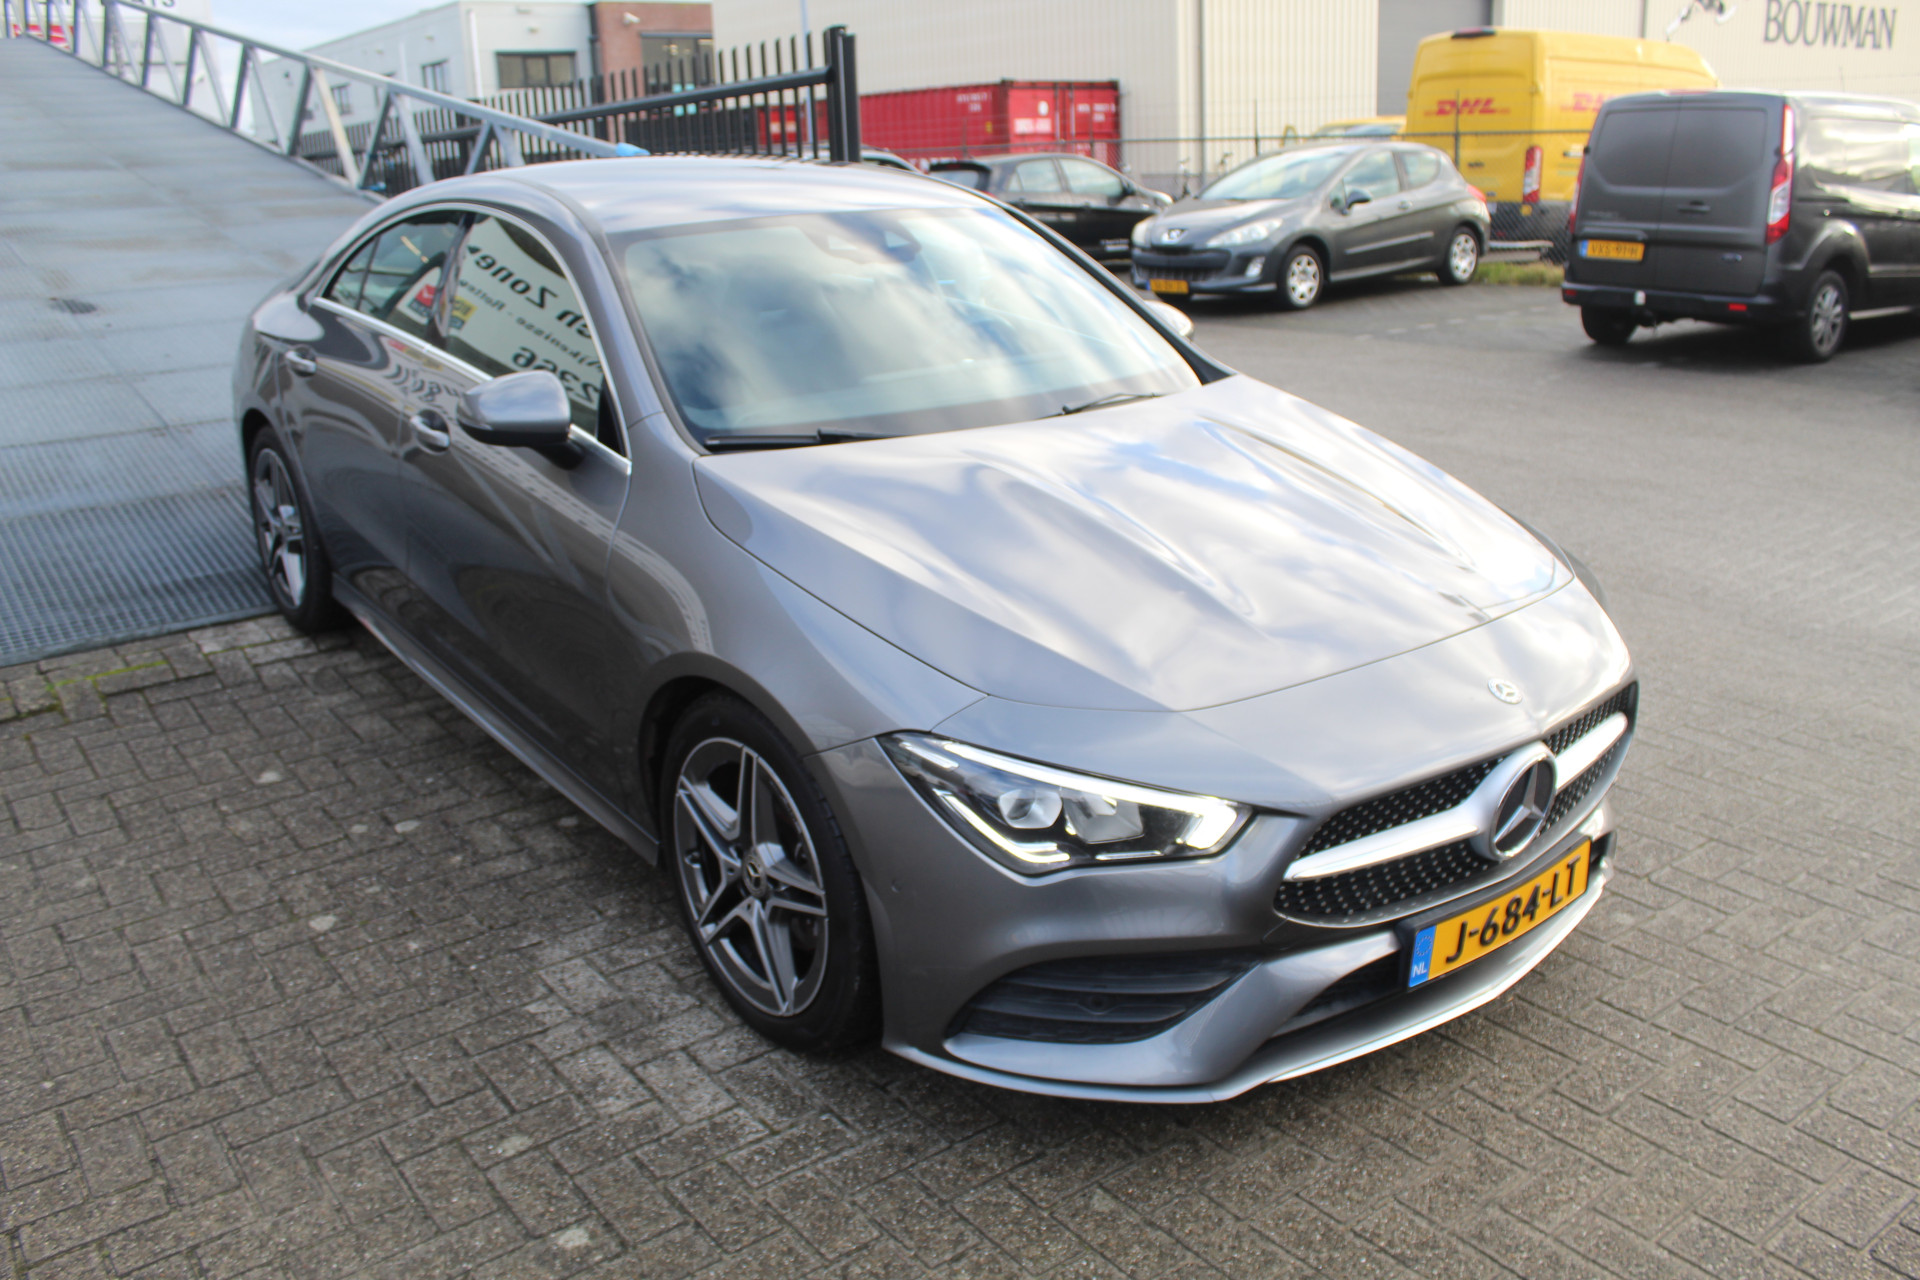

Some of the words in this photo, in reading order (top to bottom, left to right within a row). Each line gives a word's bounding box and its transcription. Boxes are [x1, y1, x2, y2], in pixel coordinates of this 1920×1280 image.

[1764, 0, 1896, 49] BOUWMAN
[1435, 97, 1498, 116] DHL
[1445, 855, 1581, 963] J-684-LT
[1412, 961, 1428, 978] NL
